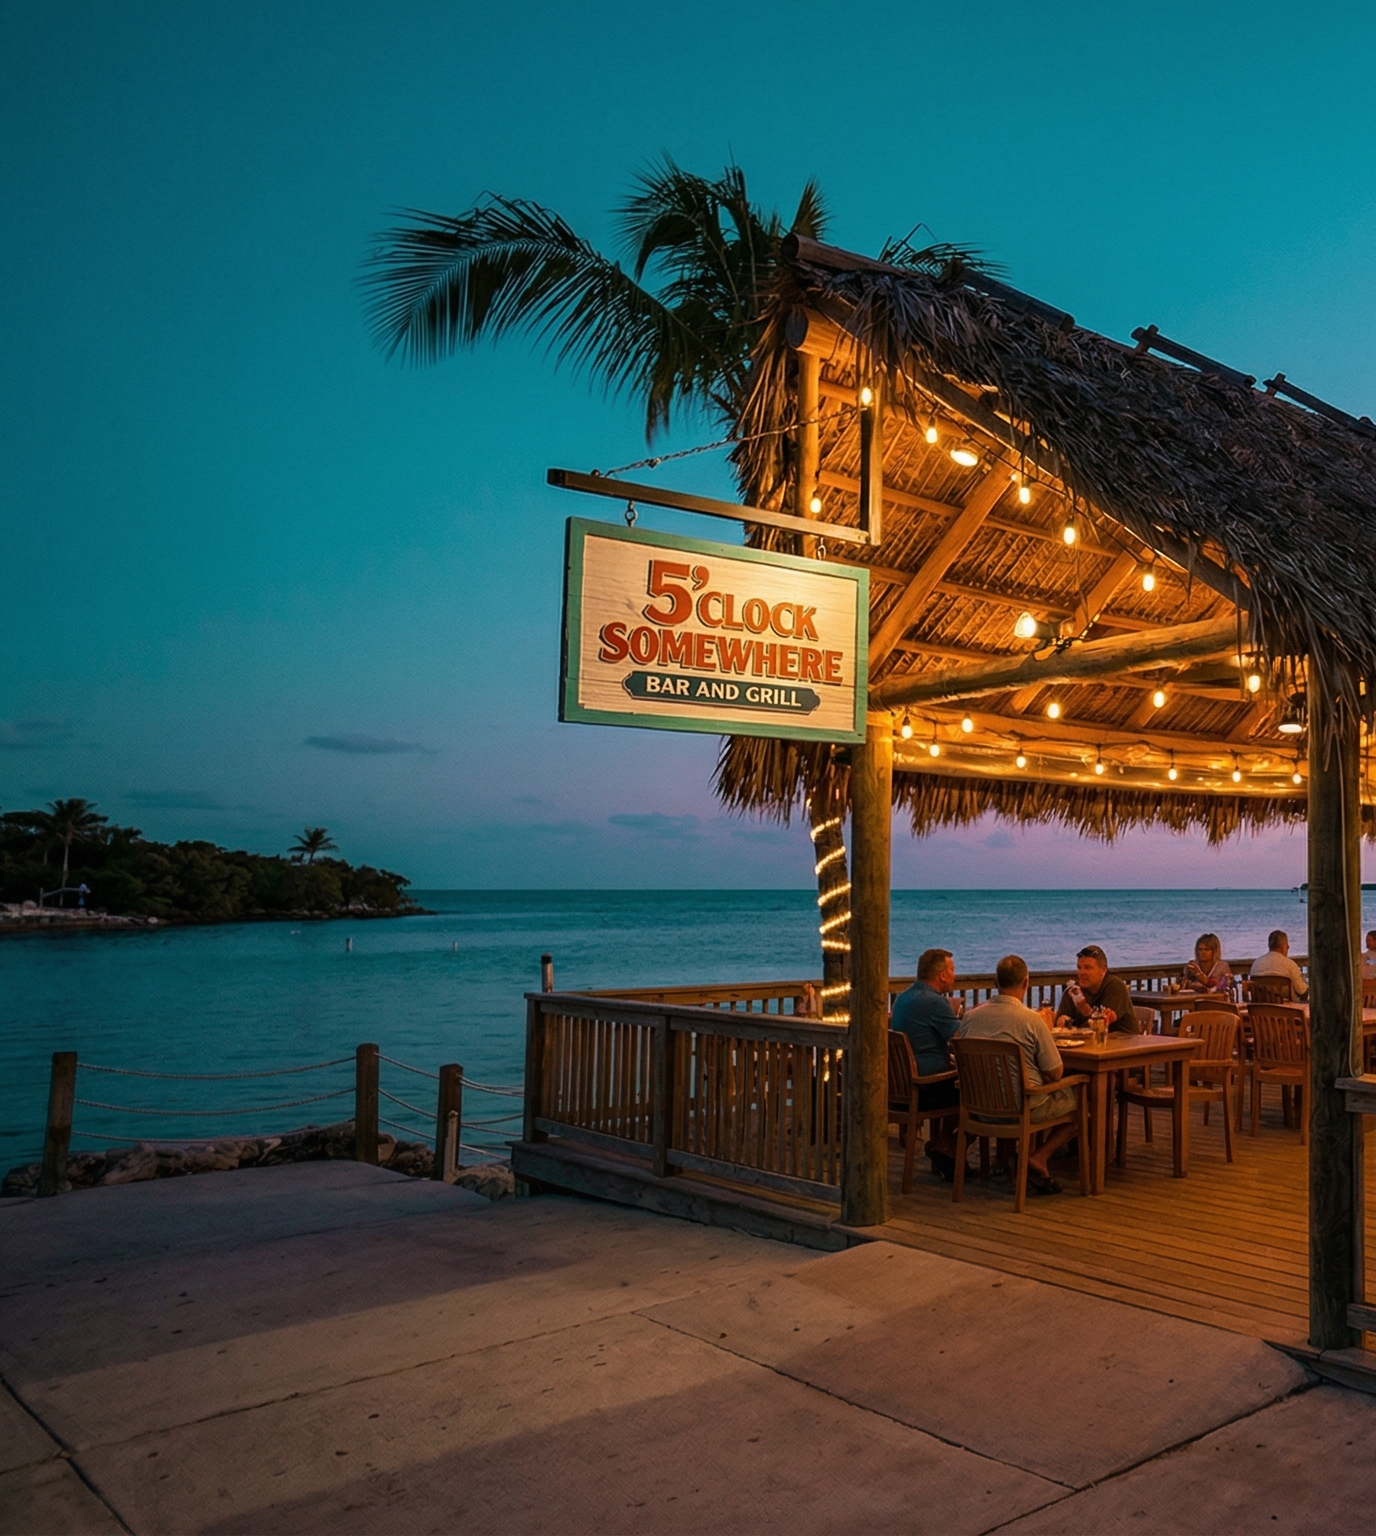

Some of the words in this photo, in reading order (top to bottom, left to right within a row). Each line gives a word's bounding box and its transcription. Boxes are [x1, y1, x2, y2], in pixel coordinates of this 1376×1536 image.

[598, 622, 844, 685] SOMEWHERE
[646, 675, 690, 697] BAR
[694, 682, 740, 701] AND
[745, 686, 802, 707] GRILL
